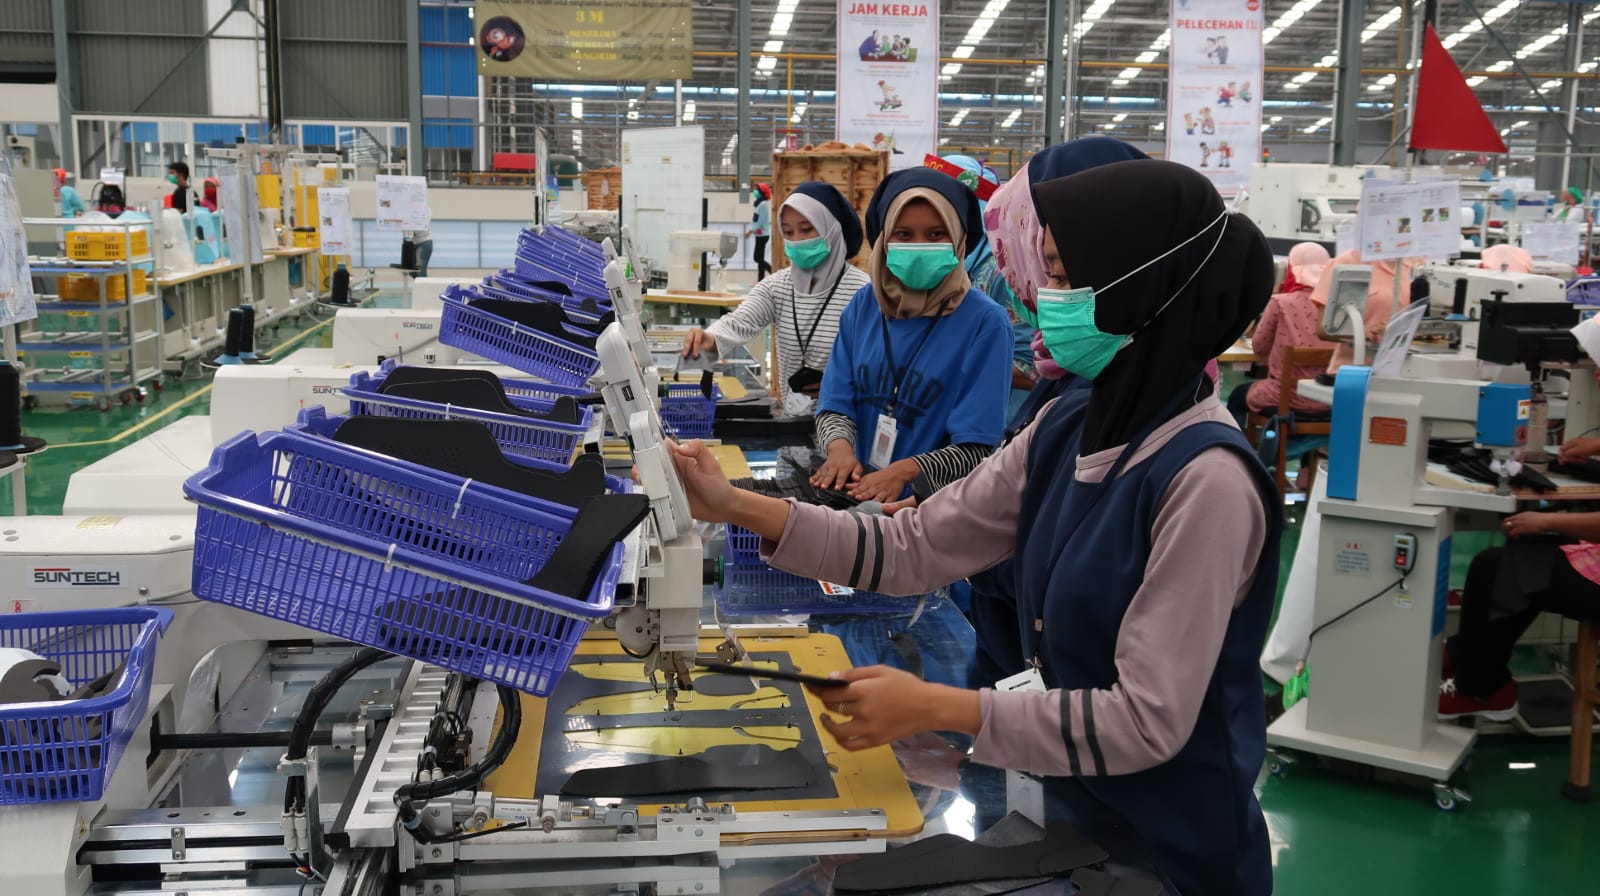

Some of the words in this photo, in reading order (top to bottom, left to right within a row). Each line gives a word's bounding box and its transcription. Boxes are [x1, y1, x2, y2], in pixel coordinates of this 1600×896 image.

[849, 3, 877, 15] JAM
[882, 4, 928, 16] KERJA
[589, 10, 605, 23] M
[1176, 19, 1243, 30] PELECEHAN
[34, 570, 120, 584] SUNTECH
